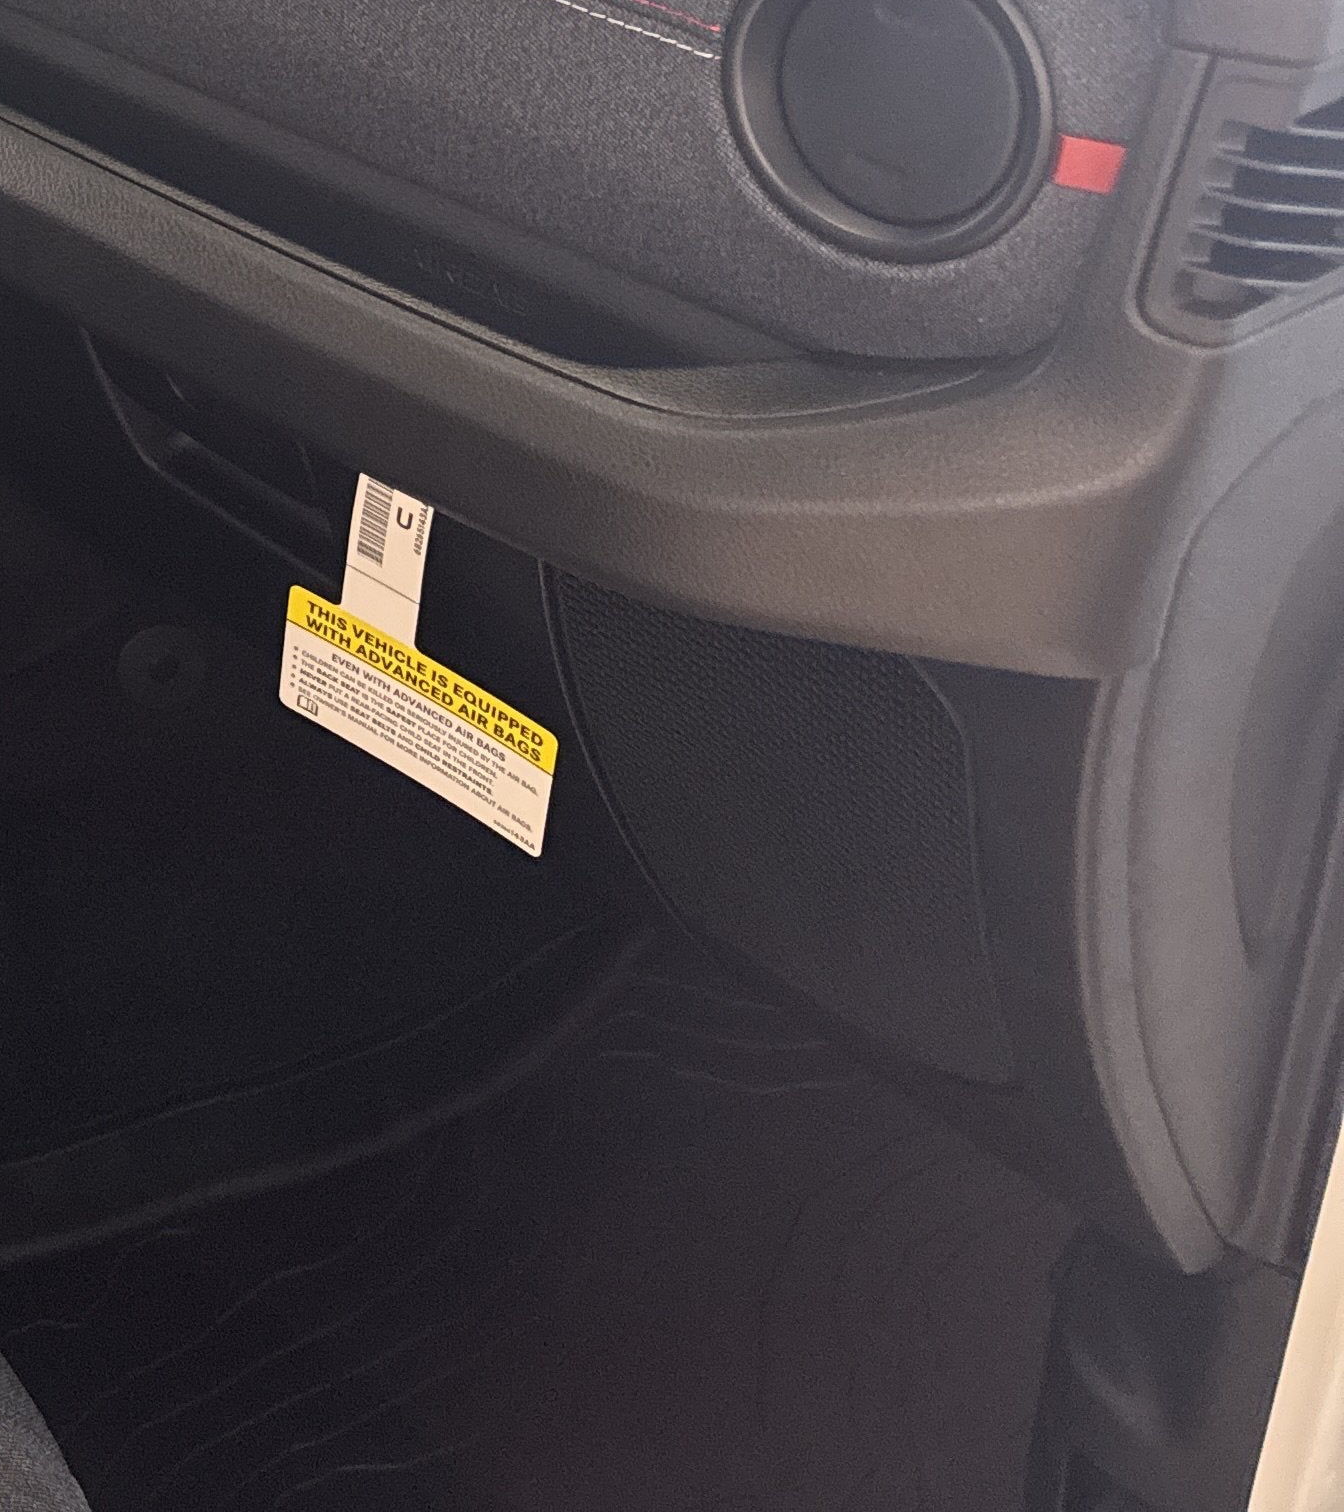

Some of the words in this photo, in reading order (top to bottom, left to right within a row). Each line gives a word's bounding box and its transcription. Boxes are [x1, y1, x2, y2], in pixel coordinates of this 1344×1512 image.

[396, 506, 414, 531] U
[299, 666, 326, 688] NEVER
[328, 682, 342, 696] PUT
[343, 691, 349, 700] A
[350, 694, 398, 728] REAR-FACING
[399, 723, 422, 742] CHILD
[423, 737, 441, 754] SEAT
[442, 749, 451, 760] IN
[452, 755, 467, 770] THE
[468, 765, 494, 787] FRONT.
[301, 657, 315, 672] THE
[316, 665, 339, 685] BACK
[340, 679, 360, 697] SEAT
[361, 691, 368, 701] IS
[370, 696, 384, 710] THE
[385, 705, 416, 729] SAFEST
[417, 724, 440, 744] PLACE
[442, 739, 457, 754] FOR
[458, 749, 498, 779] CHILDREN.
[301, 647, 338, 675] CHILDREN
[339, 669, 355, 684] CAN
[356, 679, 366, 690] BE
[367, 685, 393, 706] KILLED
[394, 701, 405, 713] OR
[406, 708, 446, 737] SERIOUSLY
[447, 732, 479, 757] INJURED
[480, 752, 490, 765] BY
[491, 759, 505, 774] THE
[507, 770, 520, 784] AIR
[520, 779, 538, 796] BAG.
[305, 612, 351, 650] WITH
[355, 640, 454, 709] ADVANCED
[457, 701, 488, 730] AIR
[492, 722, 542, 763] BAGS
[306, 598, 347, 633] THIS
[351, 623, 427, 678] VEHICLE
[431, 669, 448, 689] IS
[452, 682, 544, 749] EQUIPPED
[331, 651, 360, 676] EVEN
[362, 668, 390, 693] WITH
[392, 686, 452, 729] ADVANCED
[455, 723, 474, 742] AIR
[476, 737, 505, 762] BAGS
[298, 674, 332, 701] ALWAYS
[333, 694, 348, 709] USE
[349, 704, 369, 721] SEAT
[371, 716, 396, 736] BELTS
[397, 731, 413, 746] AND
[414, 742, 440, 763] CHILD
[441, 758, 493, 796] RESTRAINTS.
